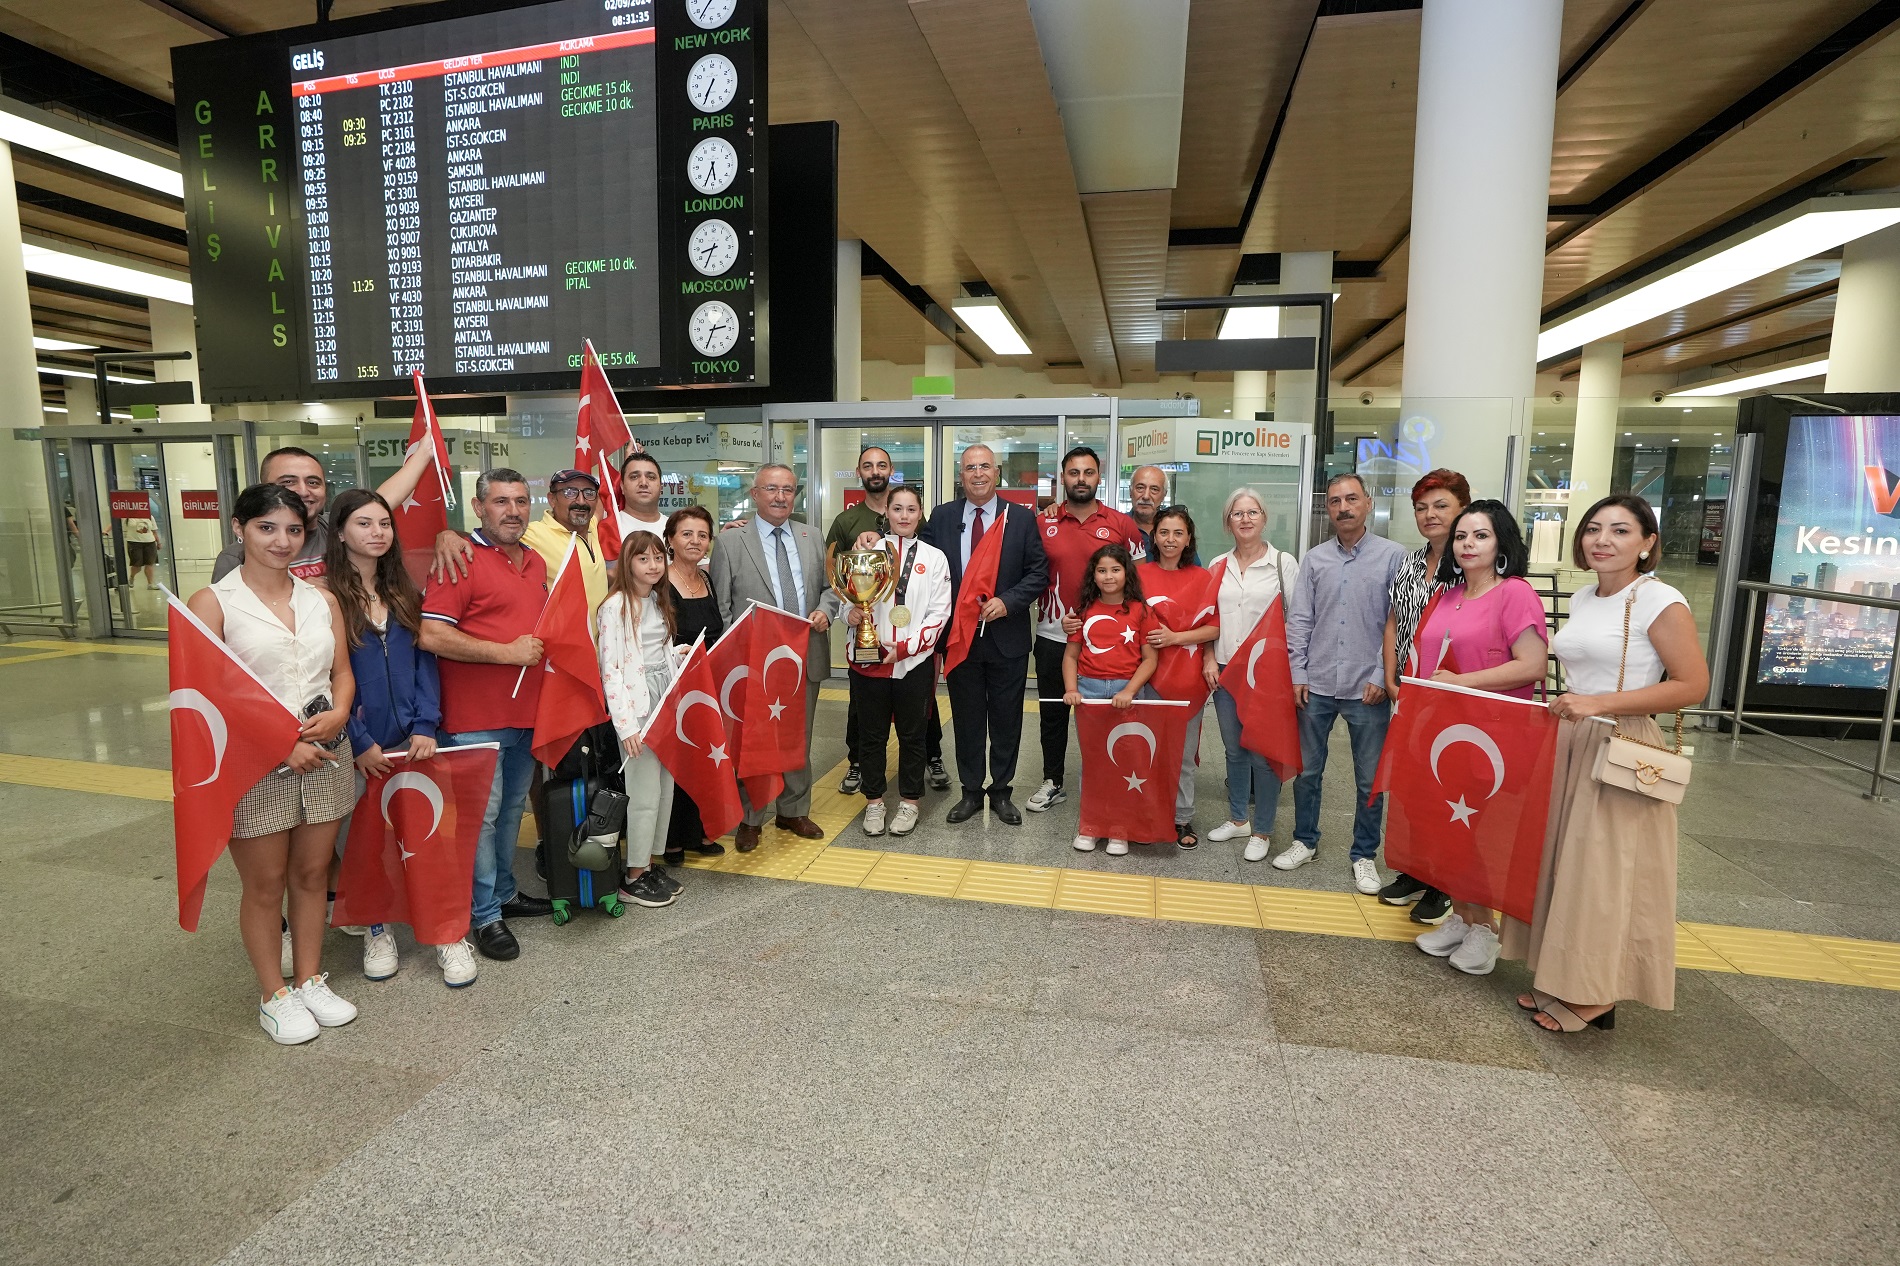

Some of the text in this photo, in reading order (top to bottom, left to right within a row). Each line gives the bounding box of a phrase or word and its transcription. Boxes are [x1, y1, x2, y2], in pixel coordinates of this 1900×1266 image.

[612, 11, 650, 26] 08:31:35
[675, 27, 750, 50] NEW YORK
[293, 49, 324, 70] GELİŞ
[299, 55, 579, 108] 08:10 TK 2310 ISTANBUL HAVALIMANI INDI
[300, 109, 322, 123] 08:40
[380, 99, 392, 112] PC
[393, 95, 413, 109] 2182
[561, 71, 580, 86] INDI
[301, 124, 323, 138] 09:15
[343, 117, 366, 132] 09:30
[381, 114, 392, 127] TK
[393, 111, 414, 125] 2312
[445, 101, 487, 117] ISTANBUL
[489, 92, 543, 112] HAVALIMANI
[561, 84, 602, 102] GECIKME
[605, 82, 617, 96] 15
[302, 138, 324, 152] 09:15
[344, 133, 367, 147] 09:25
[382, 129, 393, 142] PC
[395, 126, 415, 140] 3161
[446, 117, 481, 133] ANKARA
[562, 100, 602, 118] GECIKME
[605, 98, 617, 111] 10
[693, 114, 734, 131] PARIS
[303, 153, 325, 167] 09:20
[382, 144, 394, 157] PC
[395, 141, 416, 155] 2184
[304, 148, 482, 181] 09:25 VF 4028 ANKARA
[305, 163, 484, 196] 09:55 XQ 9159 SAMSUN
[306, 171, 545, 210] 09:55 PC 3301 ISTANBUL HAVALIMANI
[307, 194, 484, 225] 10:00 XQ 9039 KAYSERI
[684, 196, 744, 213] LONDON
[256, 90, 287, 347] ARRIVALS
[308, 207, 497, 239] 10:10 XQ 9129 GAZIANTEP
[309, 223, 497, 254] 10:10 XQ 9007 ÇUKUROVA
[310, 239, 489, 268] 10:15 XQ 9091 ANTALYA
[311, 254, 502, 282] 10:20 XQ 9193 DIYARBAKIR
[311, 283, 333, 296] 11:15
[352, 280, 374, 293] 11:25
[389, 278, 400, 290] TK
[401, 276, 422, 289] 2318
[452, 269, 493, 284] ISTANBUL
[494, 265, 548, 281] HAVALIMANI
[565, 259, 606, 275] GECIKME
[609, 258, 620, 272] 10
[312, 277, 591, 310] 11:40 VF 4030 ANKARA IPTAL
[682, 277, 747, 294] MOSCOW
[313, 295, 549, 324] 12:15 TK 2320 ISTANBUL HAVALIMANI
[314, 315, 488, 338] 13:20 PC 3191 KAYSERI
[315, 330, 492, 352] 13:20 XQ 9191 ANTALYA
[316, 341, 550, 366] 14:15 TK 2324 ISTANBUL HAVALIMANI
[317, 368, 338, 380] 15:00
[357, 366, 379, 378] 15:55
[393, 365, 403, 376] VF
[611, 352, 623, 365] 55
[691, 360, 740, 374] TOKYO
[663, 435, 693, 447] Kebap
[696, 434, 709, 444] Evi
[733, 438, 750, 447] Bursa
[1137, 430, 1168, 451] proline
[1222, 428, 1291, 449] proline
[113, 500, 149, 511] GİRİLMEZ
[183, 500, 219, 511] GİRİLMEZ
[1796, 526, 1898, 555] Kesin
[294, 565, 322, 577] BAD
